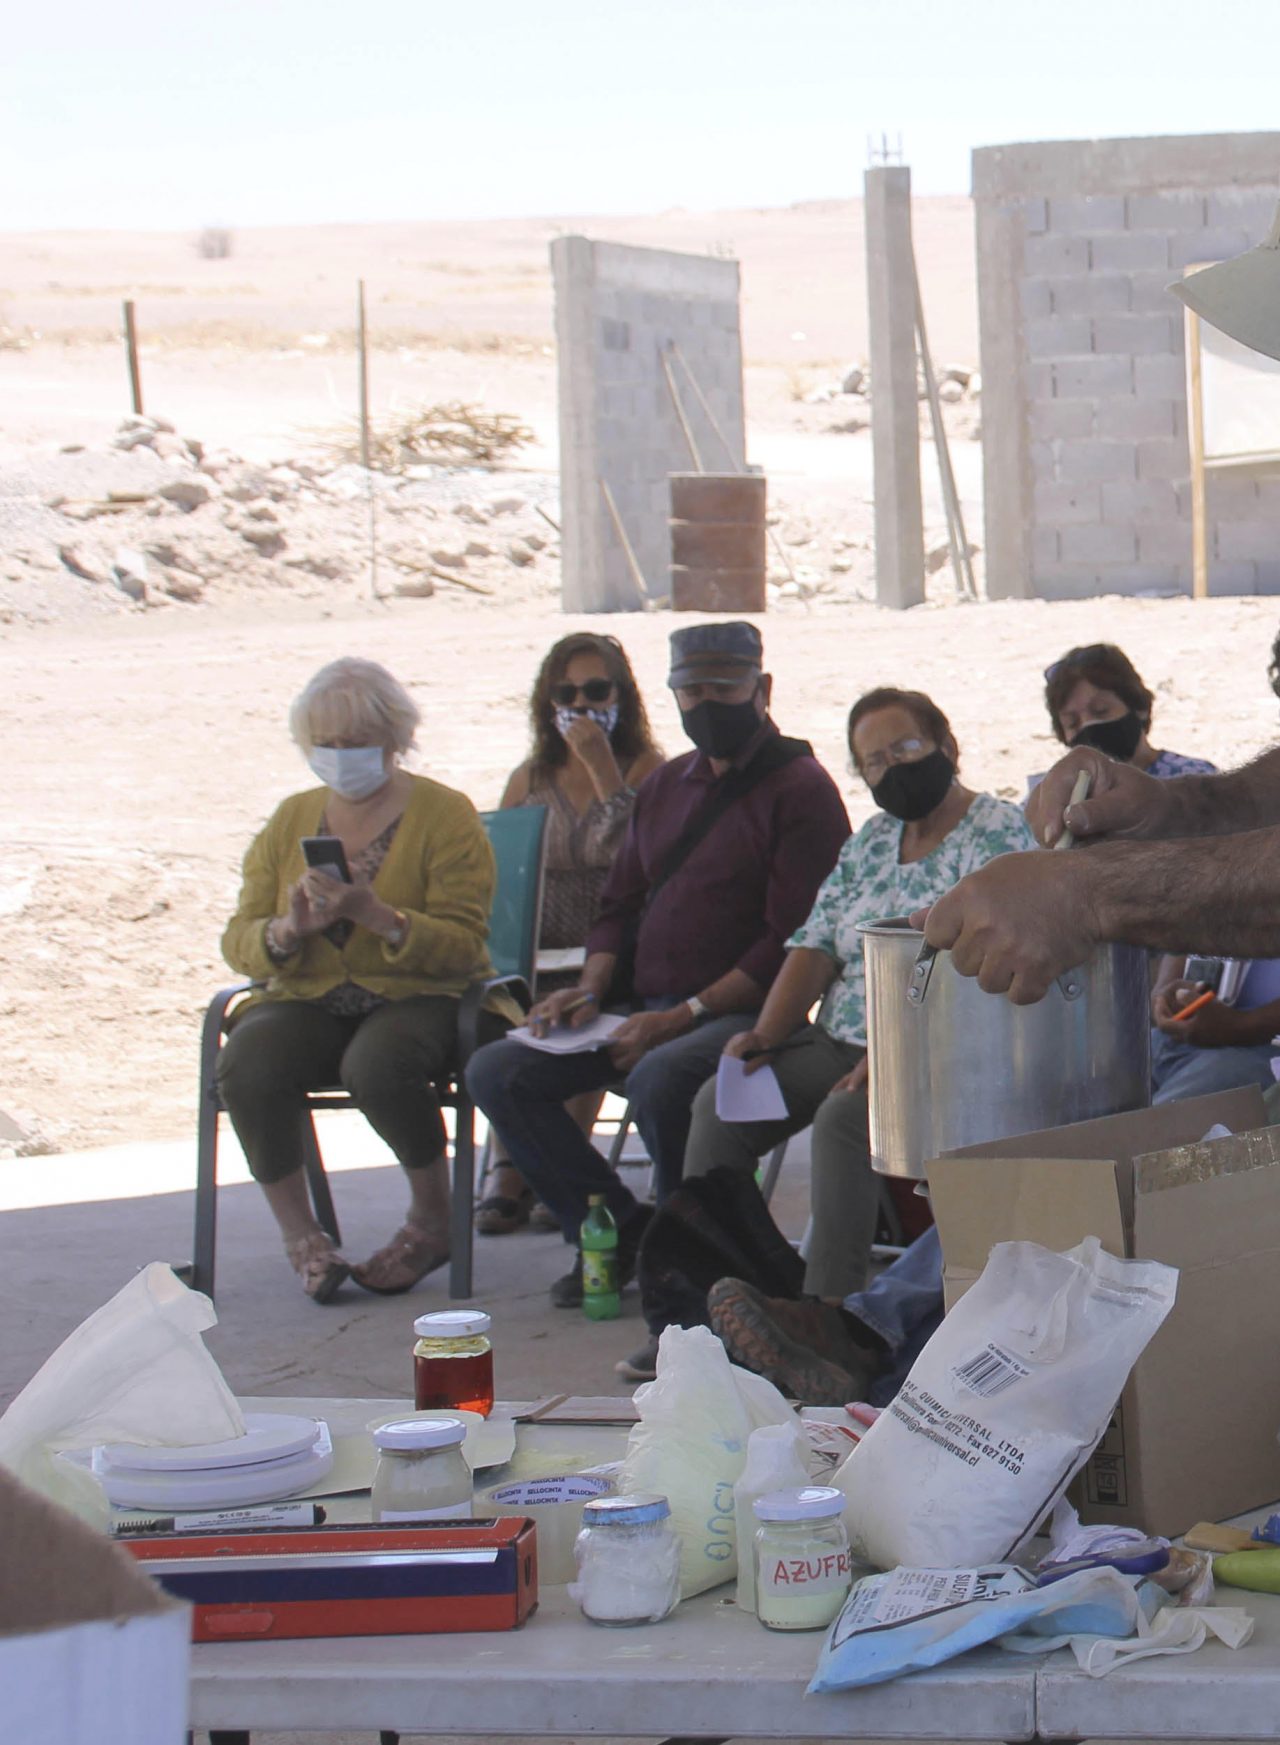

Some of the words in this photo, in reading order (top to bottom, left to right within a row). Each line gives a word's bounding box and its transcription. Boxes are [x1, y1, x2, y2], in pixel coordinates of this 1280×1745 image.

[967, 1434, 983, 1450] Fax
[982, 1444, 999, 1460] 627
[998, 1455, 1022, 1476] 9130
[998, 1440, 1026, 1465] LTDA.
[527, 1487, 562, 1495] SELLOCINTA
